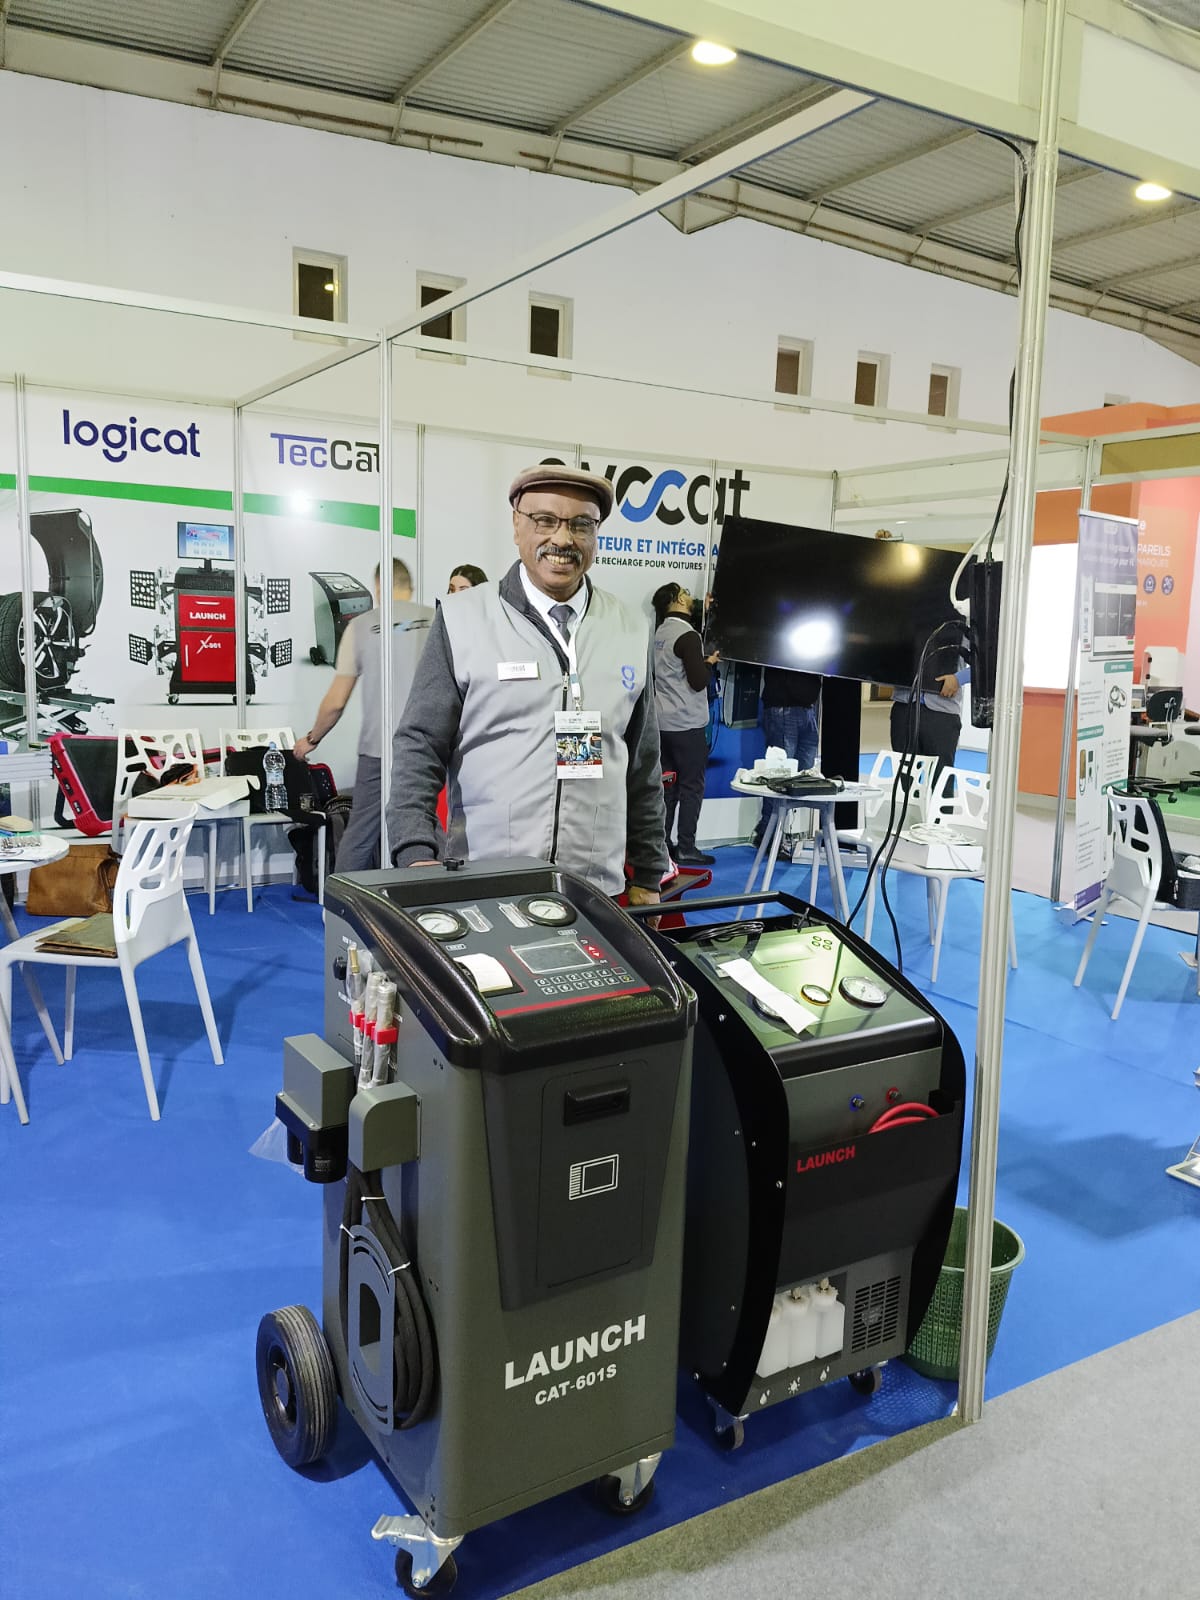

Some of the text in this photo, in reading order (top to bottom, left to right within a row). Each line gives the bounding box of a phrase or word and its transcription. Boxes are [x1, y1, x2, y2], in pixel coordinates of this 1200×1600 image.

[62, 409, 200, 463] logicat
[637, 539, 652, 553] ET
[602, 557, 643, 567] RECHARGE
[645, 560, 665, 569] POUR
[668, 561, 702, 571] VOITURES
[189, 612, 226, 620] LAUNCH
[796, 1145, 856, 1173] LAUNCH
[505, 1314, 646, 1389] LAUNCH
[535, 1364, 617, 1405] CAT-601S
